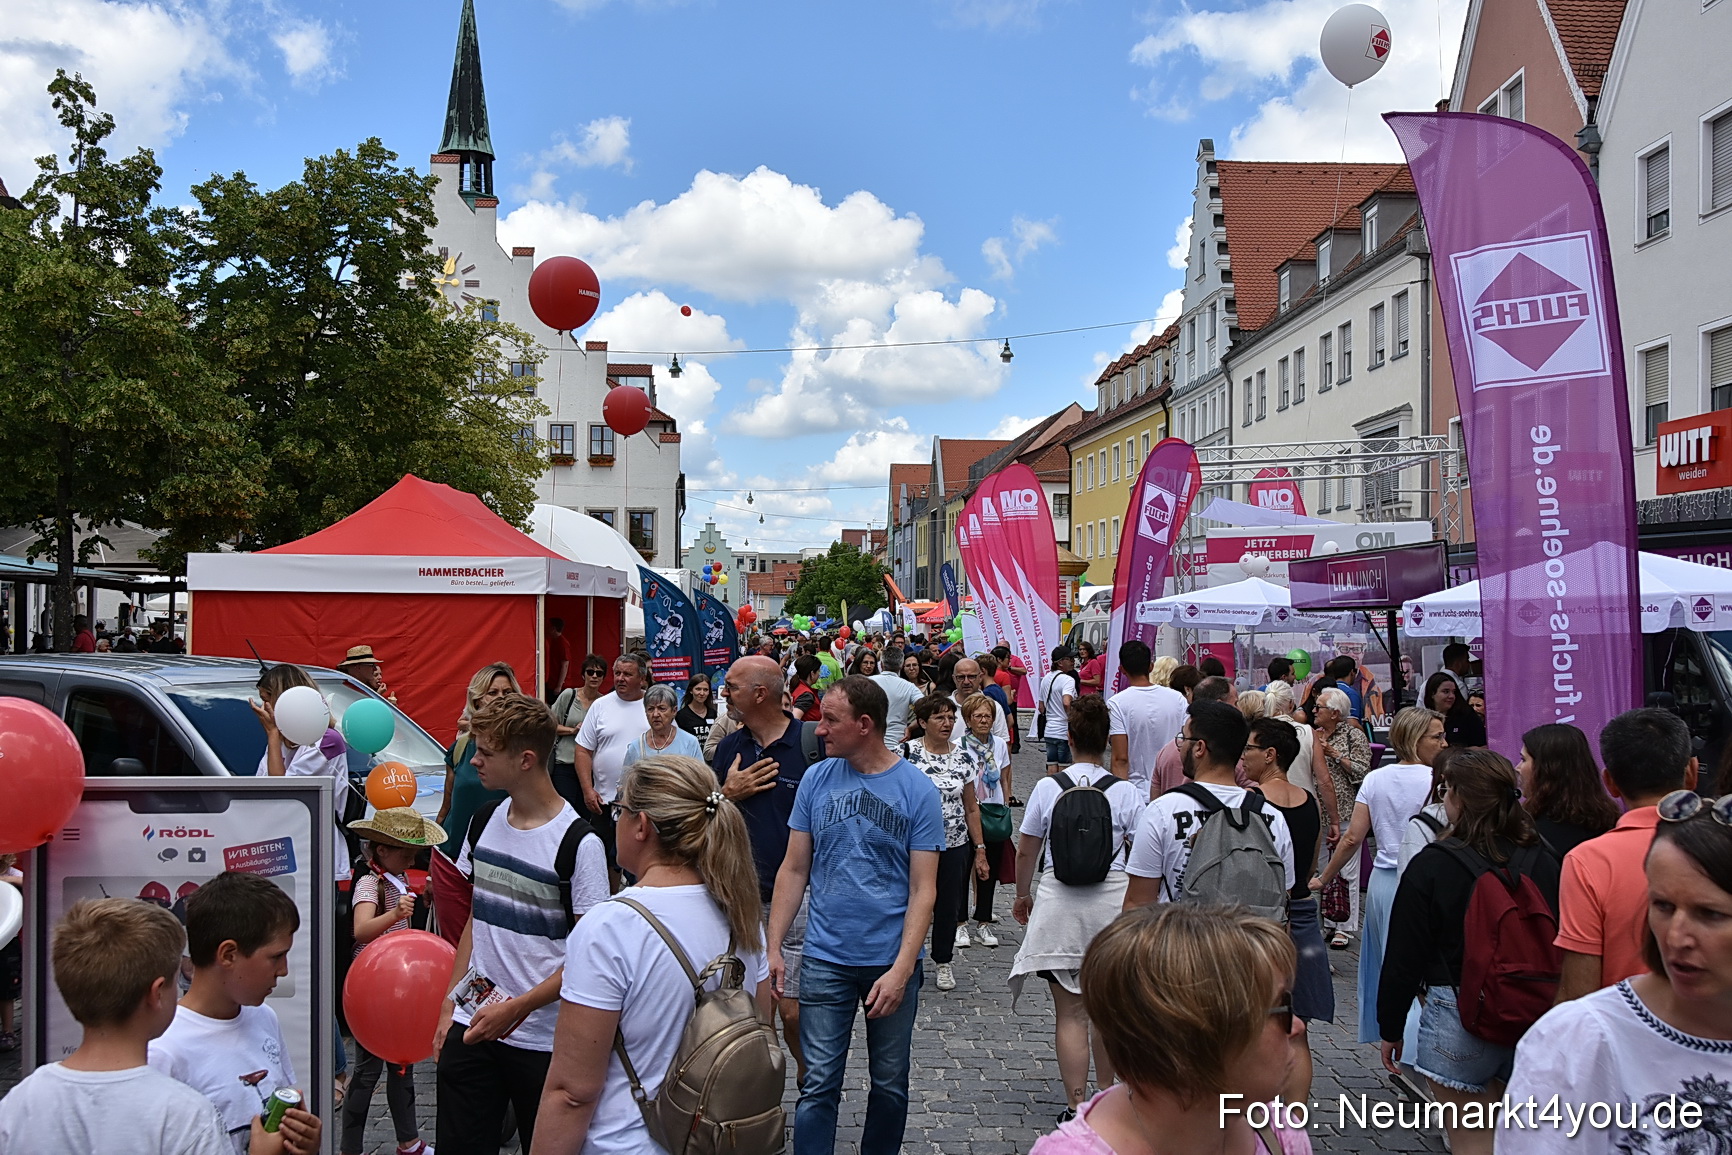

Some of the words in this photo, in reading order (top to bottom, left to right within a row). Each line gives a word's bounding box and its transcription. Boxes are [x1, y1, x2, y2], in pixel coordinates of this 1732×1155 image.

[1660, 425, 1713, 468] WITT
[1678, 466, 1707, 481] weiden
[1244, 538, 1278, 549] JETZT
[418, 567, 504, 578] HAMMERBACHER
[489, 579, 516, 588] geliefert.
[1203, 608, 1258, 616] www.fuchs-soehne.de
[693, 726, 710, 734] TEA
[382, 767, 413, 785] aha!
[159, 825, 215, 838] RÖDL
[228, 848, 249, 860] WIR
[251, 842, 286, 856] BIETEN:
[235, 857, 275, 869] Ausbildungs-
[276, 854, 288, 862] und
